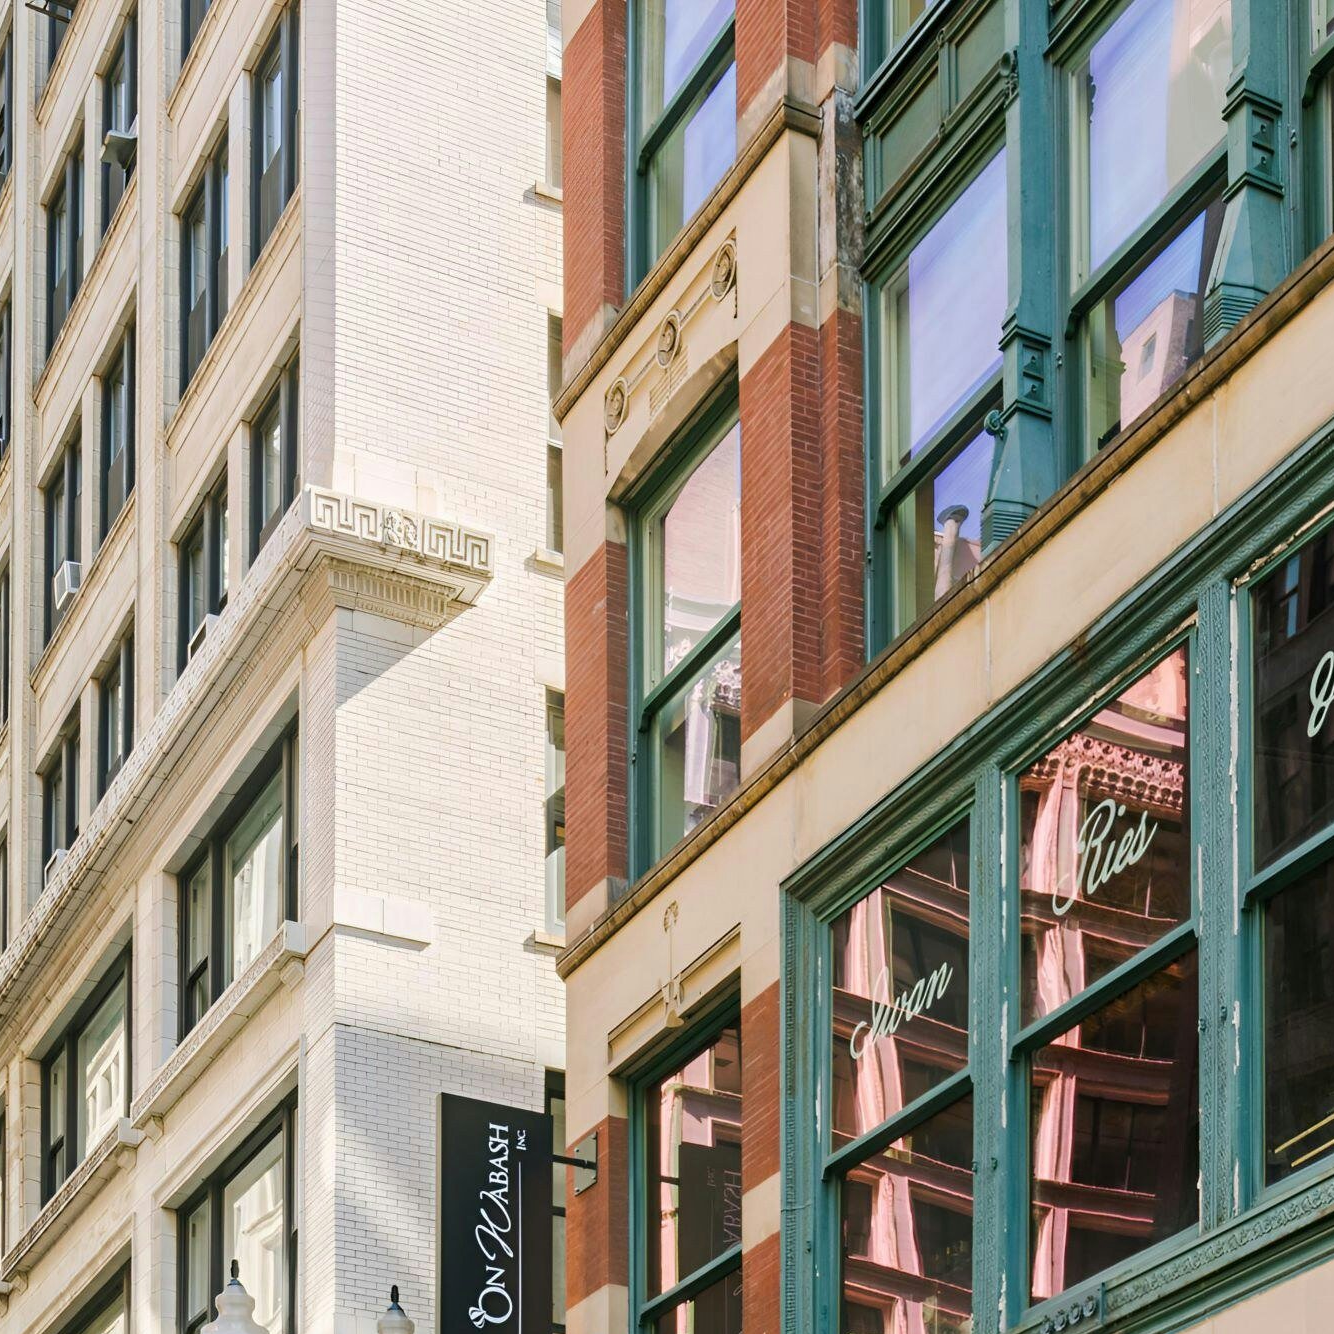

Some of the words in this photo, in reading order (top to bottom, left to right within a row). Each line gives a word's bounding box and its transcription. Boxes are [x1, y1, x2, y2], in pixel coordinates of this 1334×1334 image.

[850, 960, 954, 1060] Iwan
[1052, 798, 1158, 916] Ries
[474, 1121, 514, 1262] WABASH
[476, 1264, 513, 1327] ON
